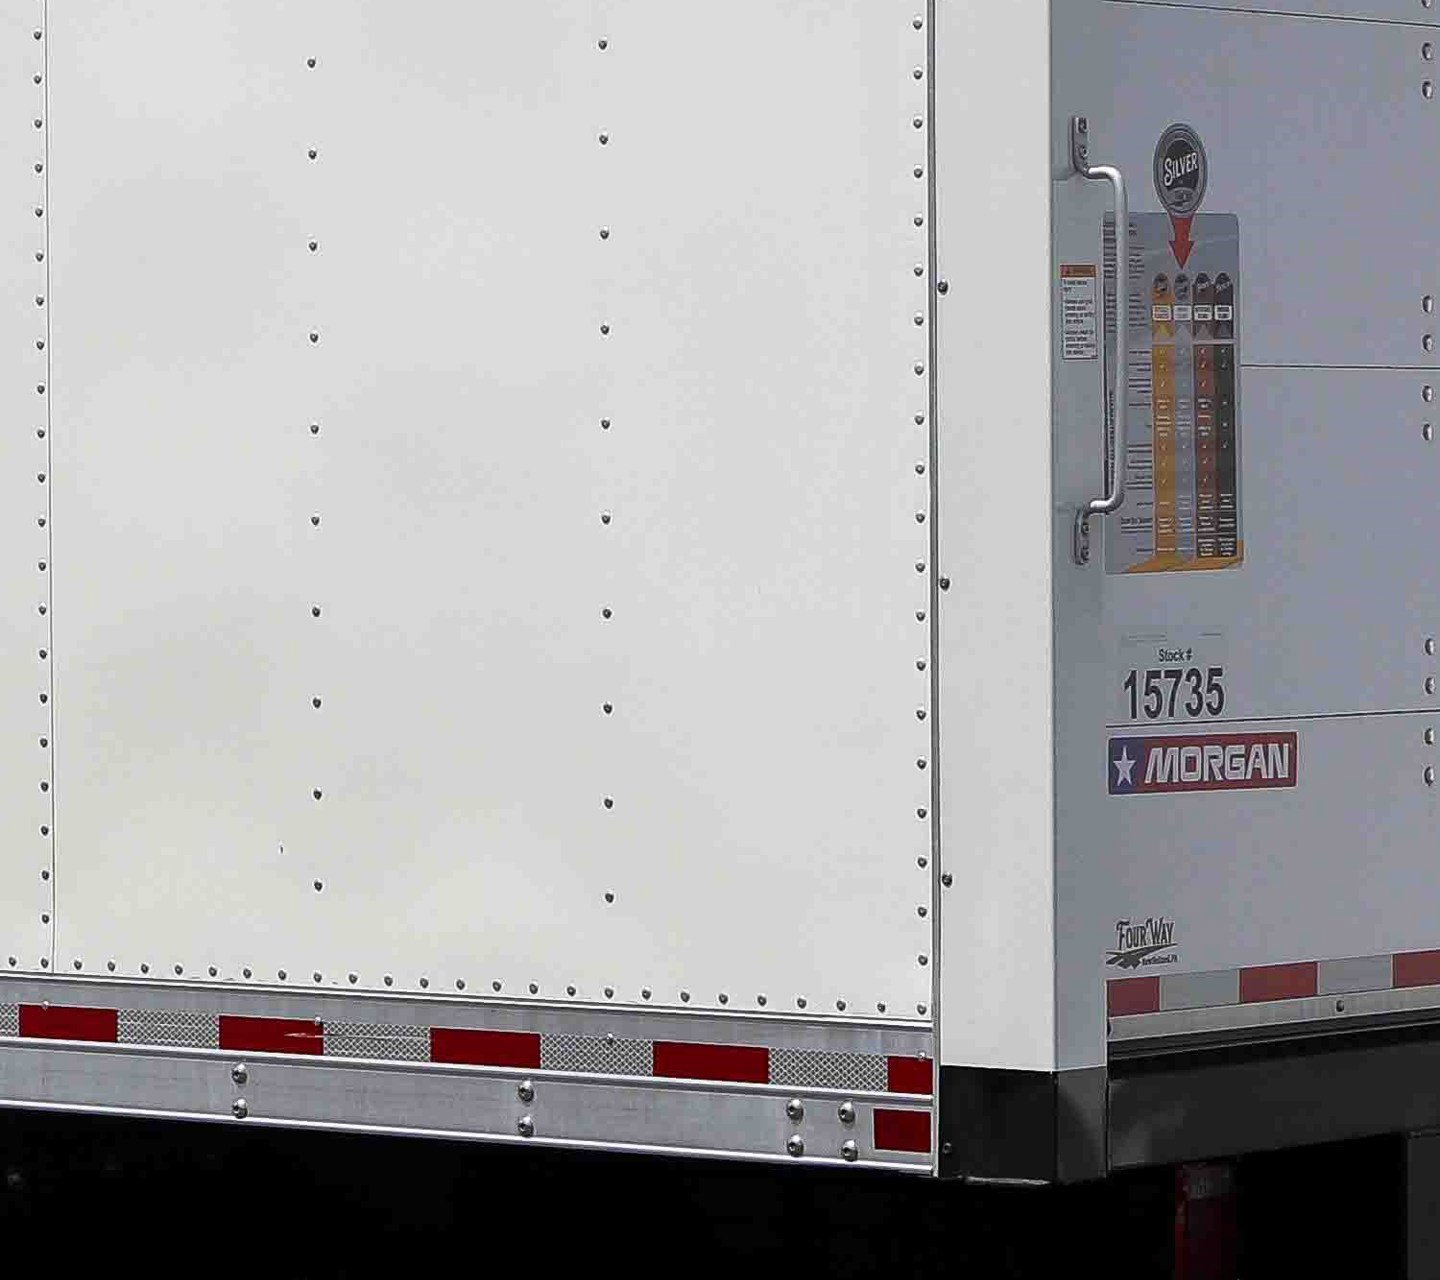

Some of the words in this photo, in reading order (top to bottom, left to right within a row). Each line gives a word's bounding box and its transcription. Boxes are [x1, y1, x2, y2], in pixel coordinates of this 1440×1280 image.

[1163, 152, 1199, 187] SILVER
[1159, 648, 1185, 662] Stock
[1123, 667, 1225, 720] 15735
[1144, 742, 1290, 784] MORGAN
